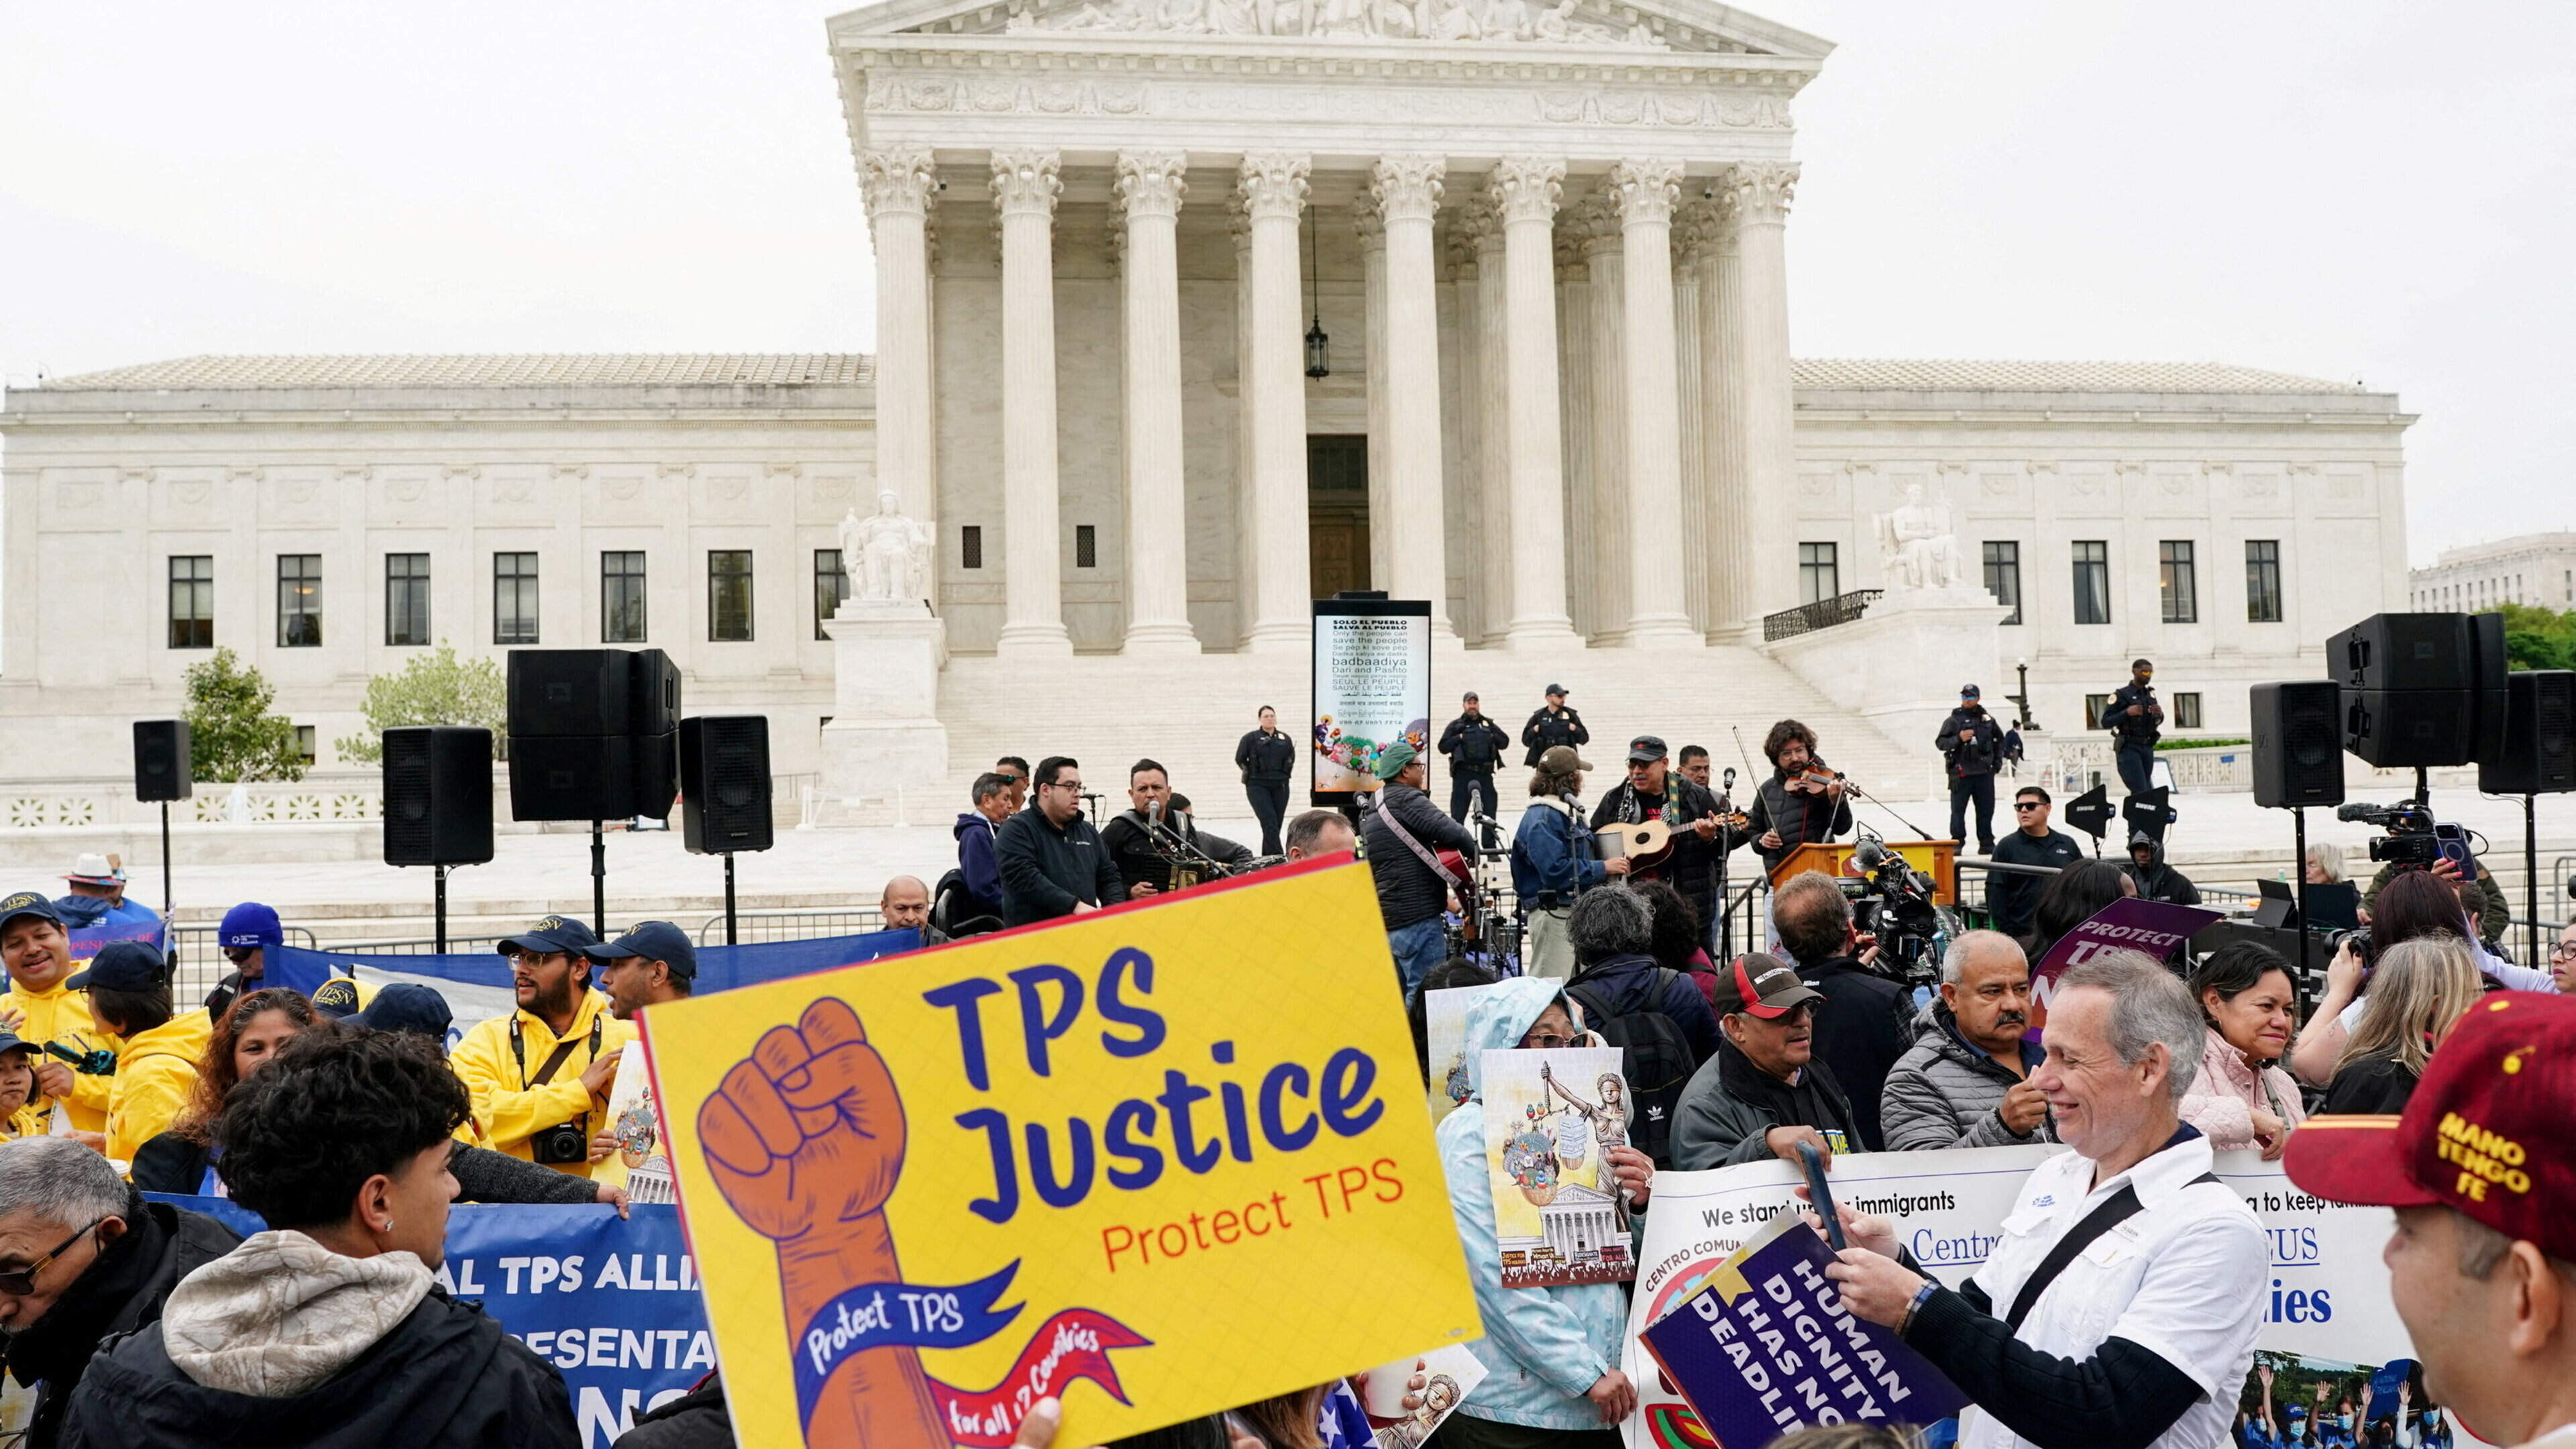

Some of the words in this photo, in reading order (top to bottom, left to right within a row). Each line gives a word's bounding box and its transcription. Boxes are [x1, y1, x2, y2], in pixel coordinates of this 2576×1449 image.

[1332, 657, 1407, 667] badbaadiya
[2135, 802, 2157, 810] SHURE
[2077, 920, 2184, 947] PROTECT
[922, 947, 1167, 1092] TPS
[955, 1040, 1385, 1224] Justice
[2437, 1111, 2526, 1167] MANO
[2436, 1133, 2531, 1195] TENGO
[2455, 1171, 2489, 1202] FE
[1101, 1192, 1293, 1273] Protect
[1303, 1158, 1404, 1218] TPS
[1702, 1208, 1734, 1228] We
[1856, 1190, 1955, 1218] immigrants
[2263, 1191, 2281, 1212] to
[2286, 1191, 2326, 1215] keep
[498, 1255, 584, 1295] TPS
[594, 1252, 702, 1291] ALLI
[1646, 1248, 1690, 1293] CENTRO
[2263, 1279, 2332, 1324] ies
[514, 1328, 716, 1370] ESENTA
[806, 1290, 893, 1376] Protect
[898, 1293, 964, 1333] TPS
[1762, 1273, 1887, 1421] DIGNITY
[1792, 1258, 1913, 1405] HUMAN
[949, 1399, 981, 1435] for
[984, 1403, 1011, 1437] all
[1013, 1385, 1032, 1421] 17
[1030, 1322, 1099, 1395] Countries
[1737, 1297, 1804, 1377] HAS
[1794, 1377, 1846, 1428] NO
